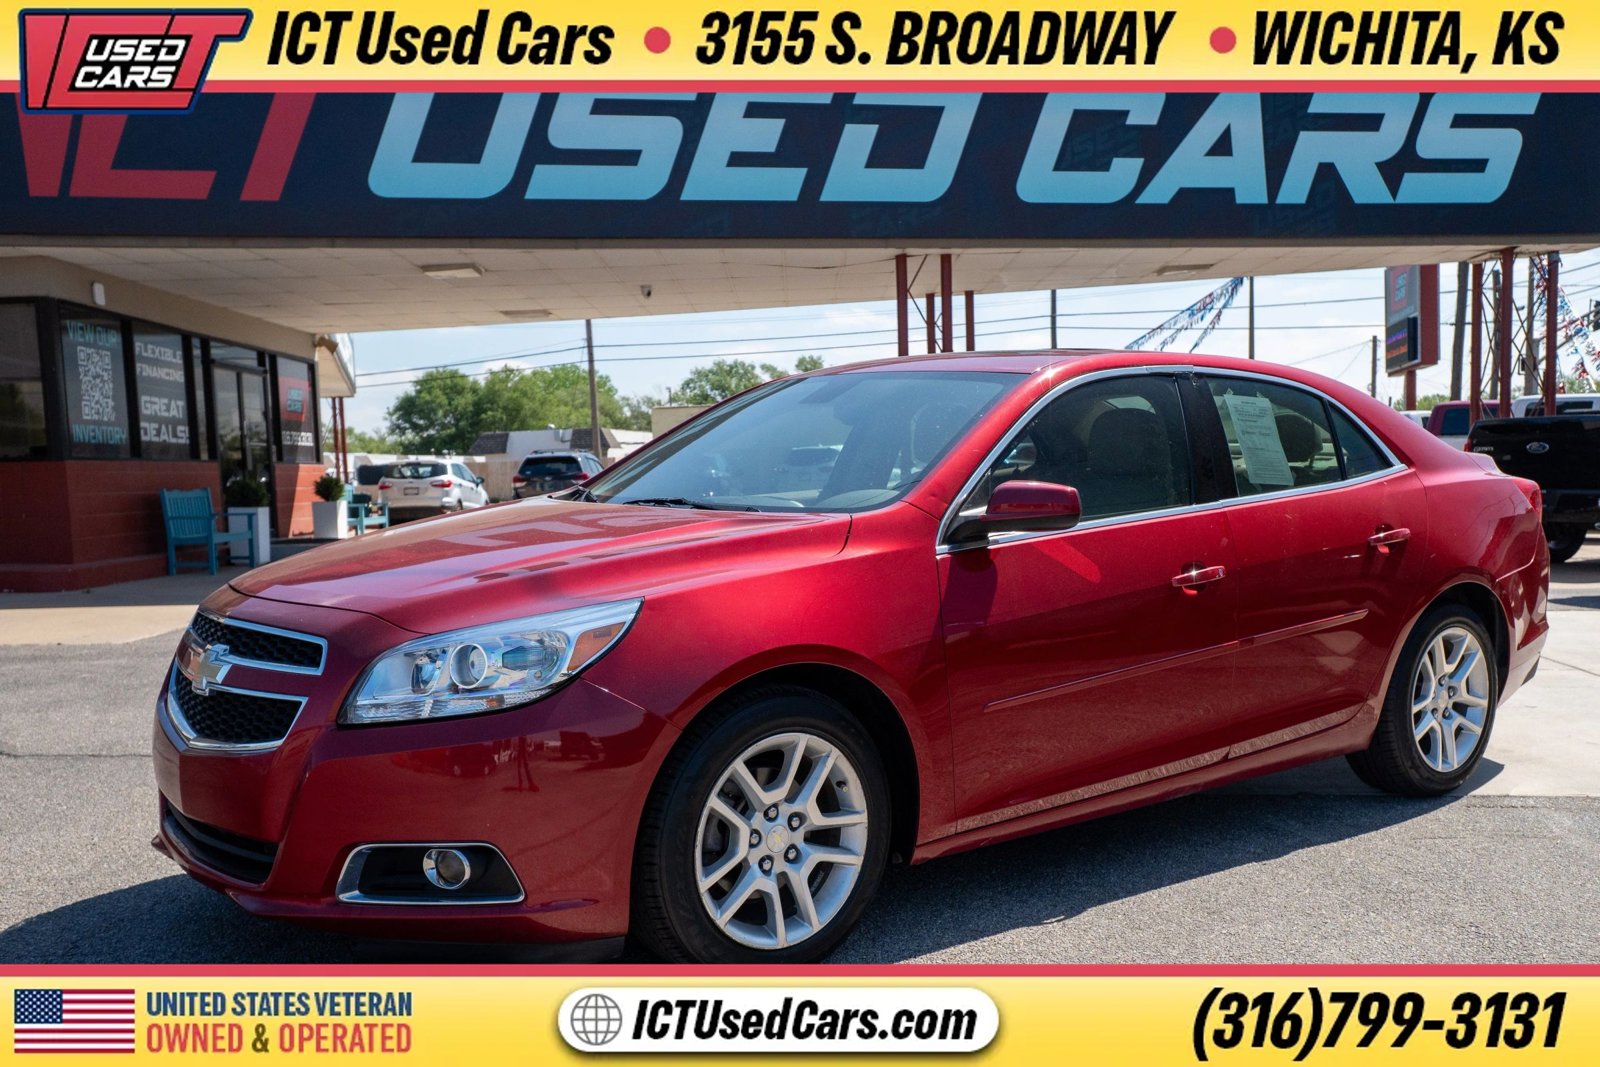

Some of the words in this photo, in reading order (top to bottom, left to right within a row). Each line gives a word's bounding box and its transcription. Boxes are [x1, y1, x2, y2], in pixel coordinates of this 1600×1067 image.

[369, 93, 982, 202] USED
[1016, 93, 1540, 204] CARS
[66, 320, 95, 343] VIEW
[96, 326, 119, 347] OUR
[135, 341, 183, 364] FLEXIBLE
[136, 363, 185, 382] FINANCING
[141, 395, 185, 418] GREAT
[72, 423, 128, 445] INVENTORY
[140, 422, 190, 445] DEALS!
